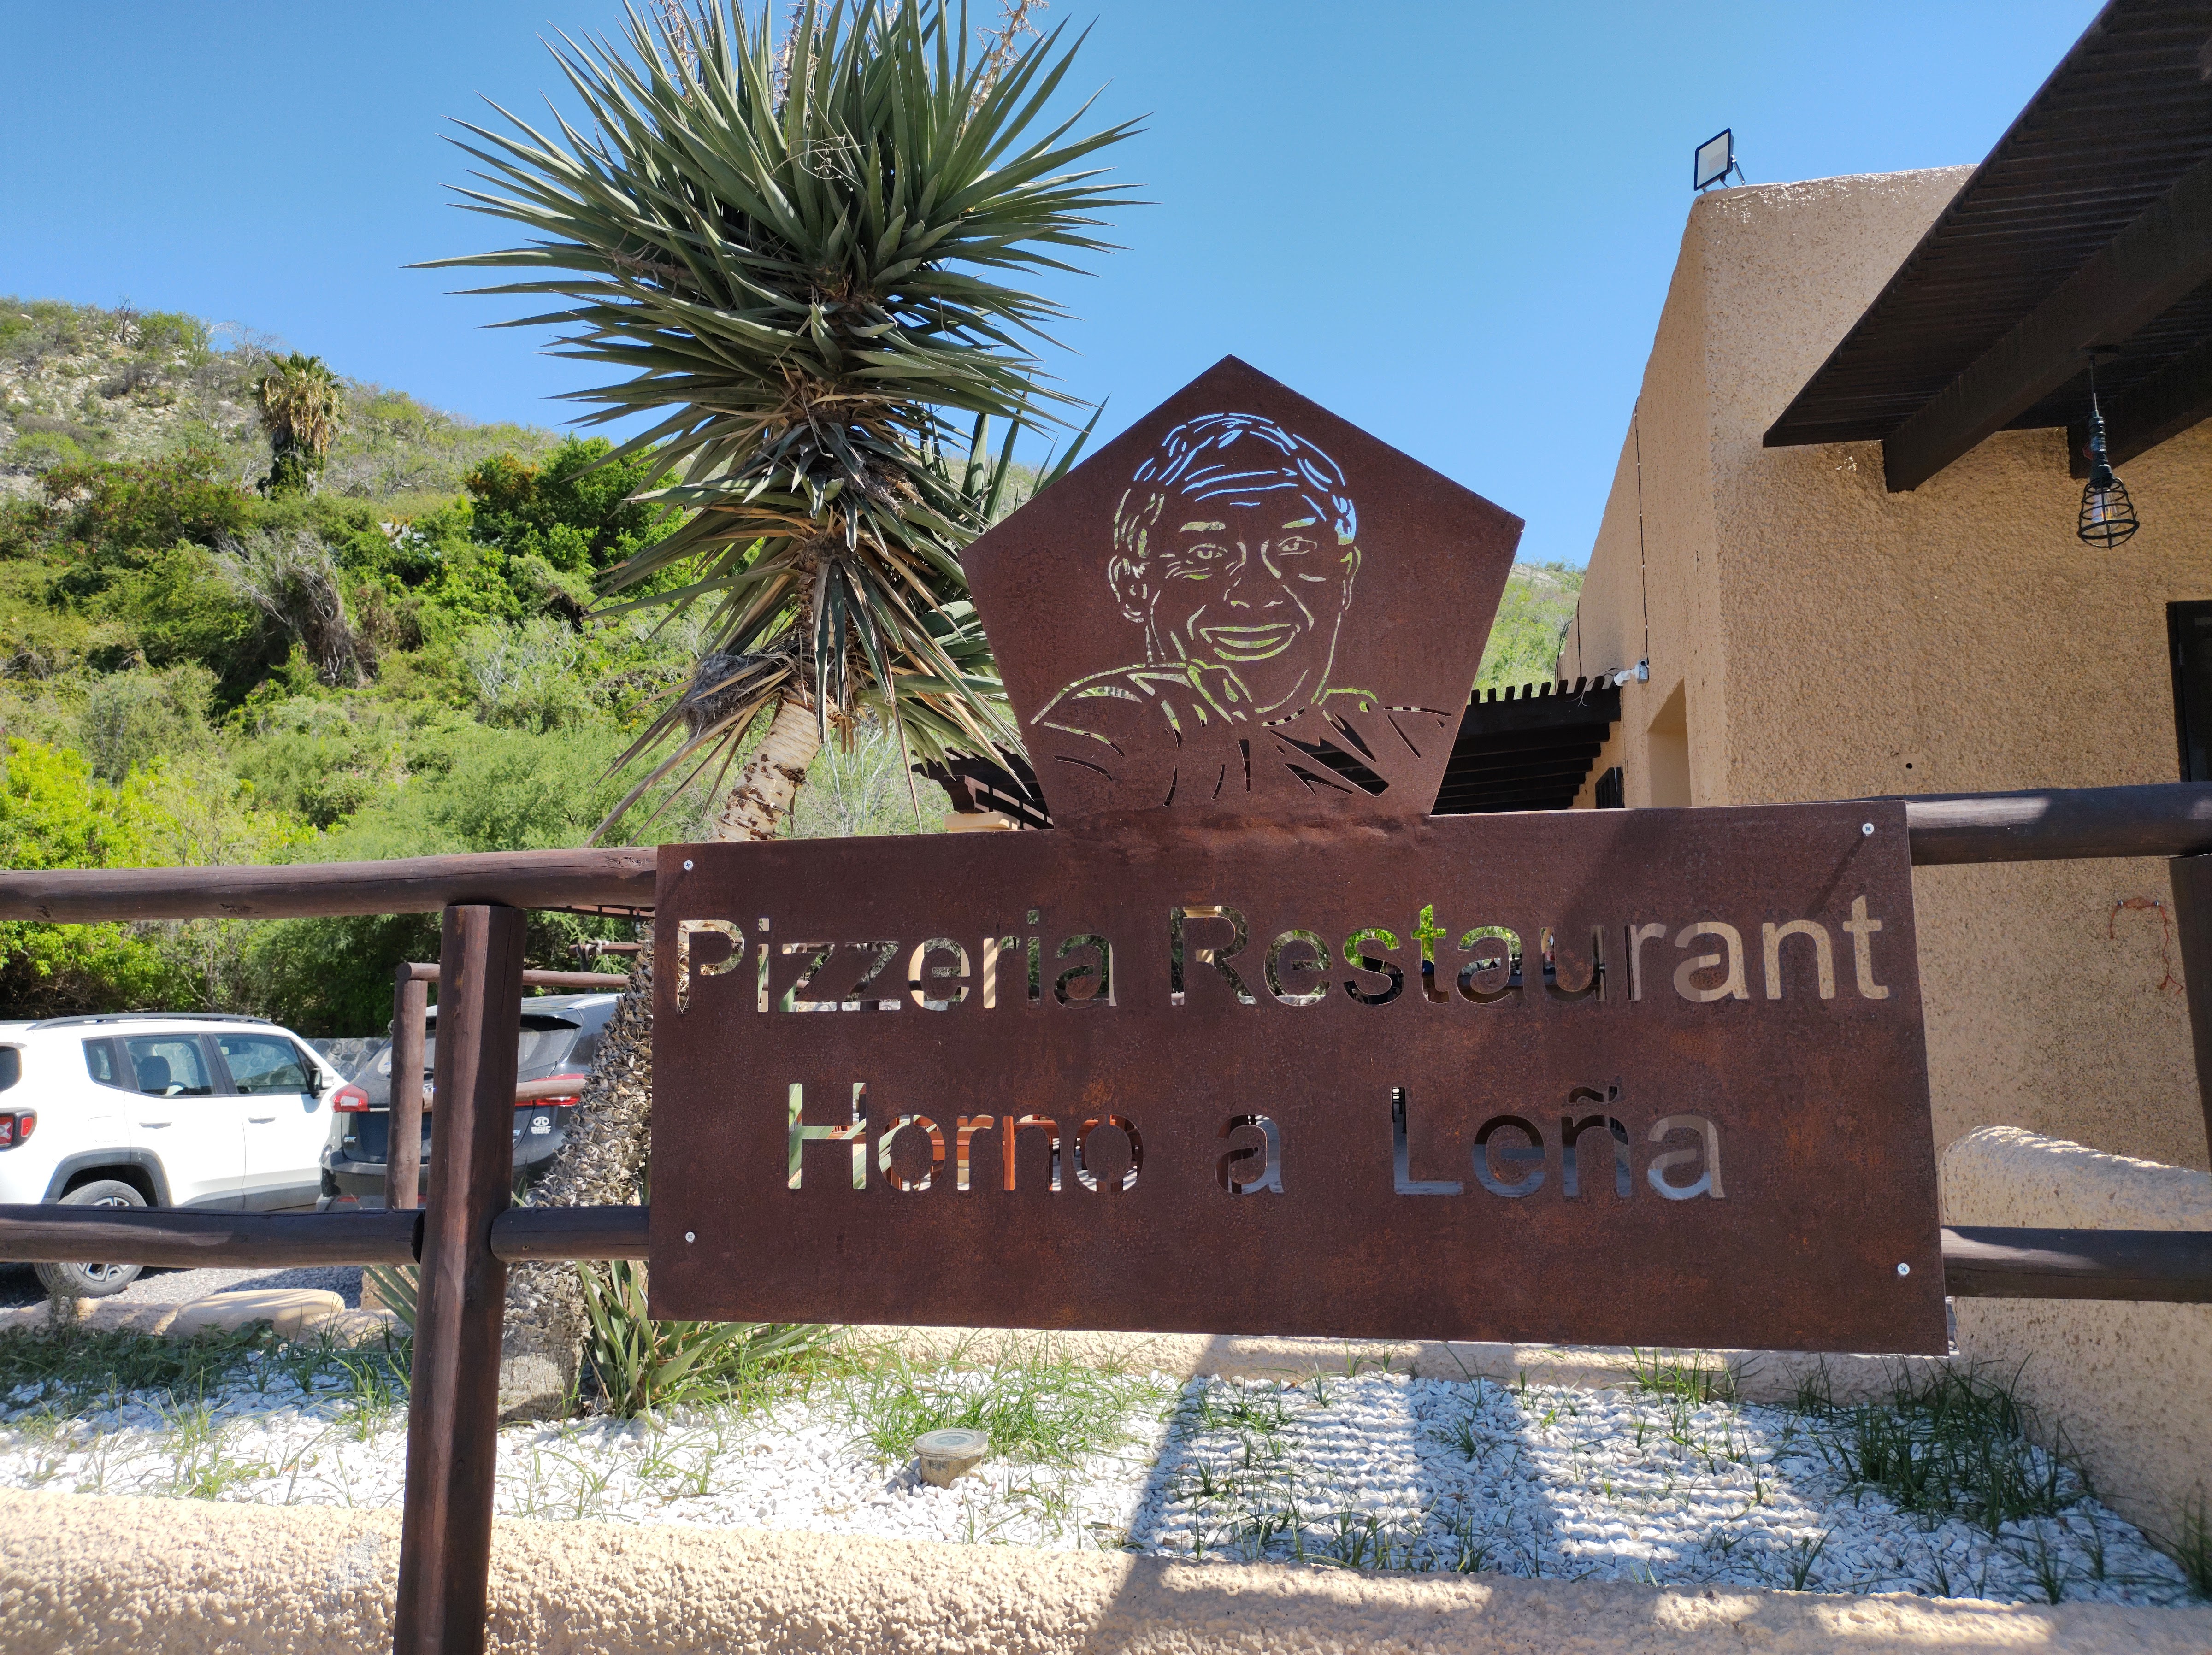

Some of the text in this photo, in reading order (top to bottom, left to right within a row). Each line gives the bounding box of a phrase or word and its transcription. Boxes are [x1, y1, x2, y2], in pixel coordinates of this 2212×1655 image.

[677, 895, 1890, 1014] Pizzeria Restaurant
[788, 1082, 1726, 1200] Horno a Leña
